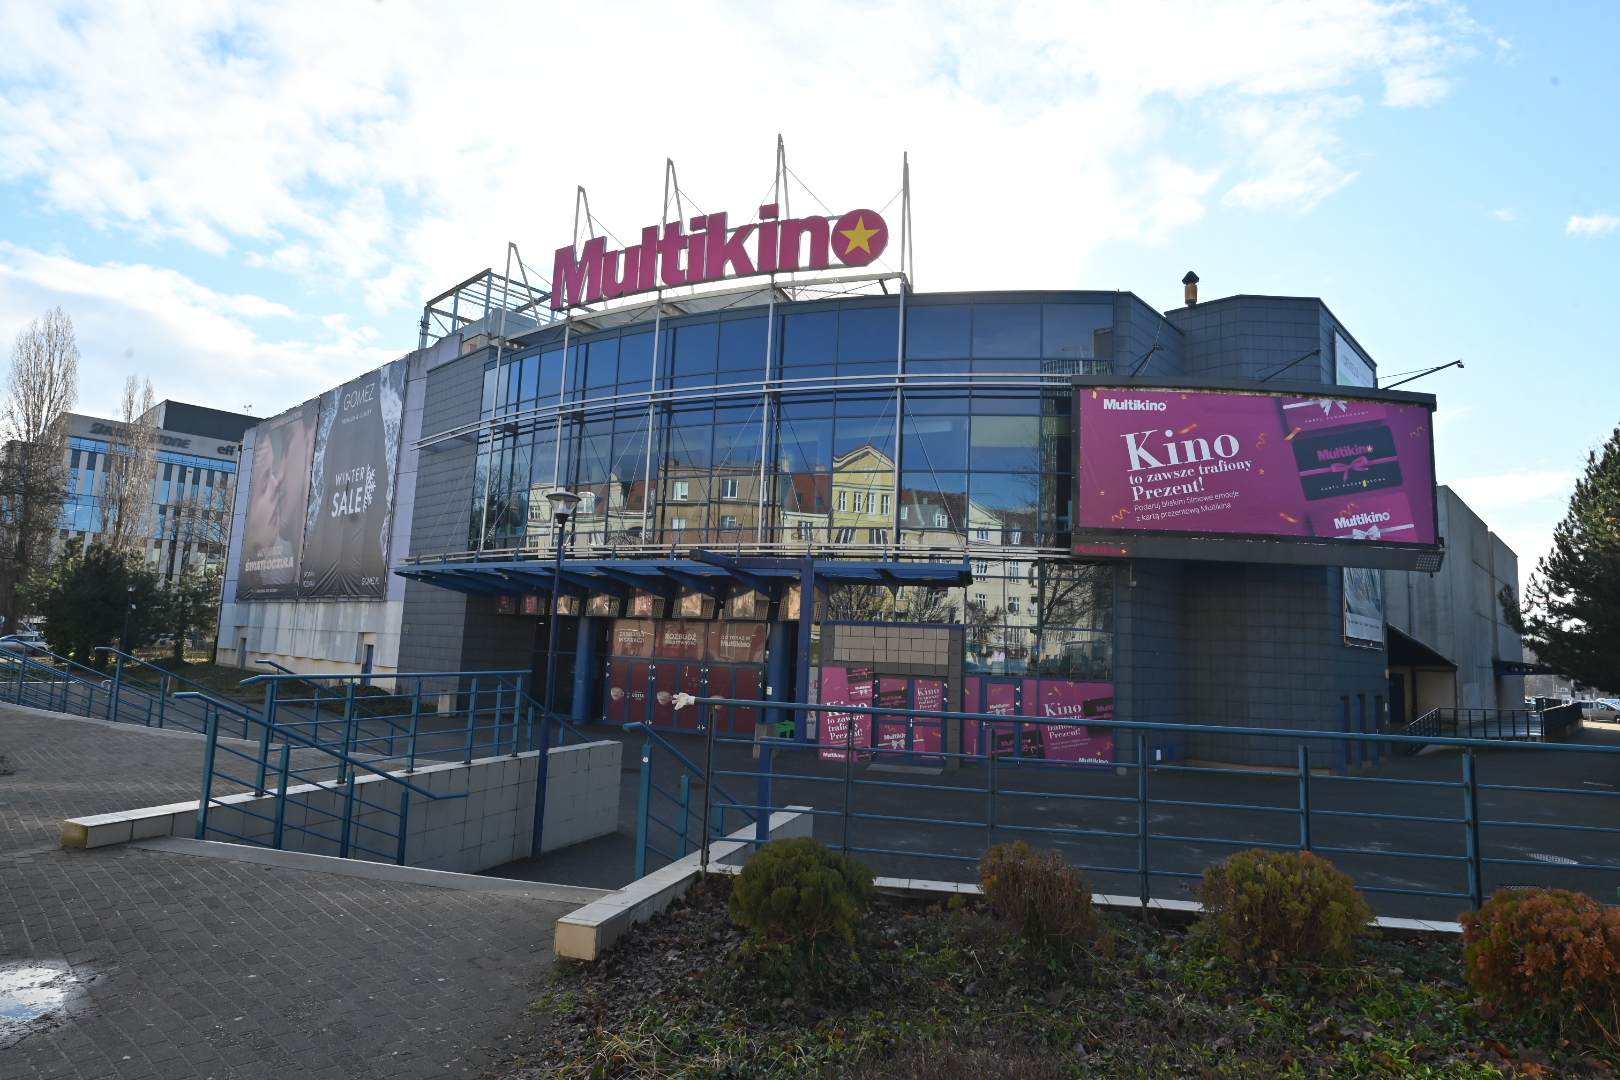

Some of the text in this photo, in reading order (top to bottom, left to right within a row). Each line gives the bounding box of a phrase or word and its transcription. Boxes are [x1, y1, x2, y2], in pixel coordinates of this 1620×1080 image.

[550, 203, 889, 311] Multikino
[343, 382, 375, 410] GOMEZ
[1103, 398, 1167, 412] Multikino
[1119, 429, 1240, 472] Kino
[1316, 444, 1374, 461] Multikino
[335, 466, 365, 487] WINTER
[1129, 459, 1252, 485] to zawsze trafiony
[1131, 476, 1205, 502] Prezent!
[331, 486, 363, 518] SALE
[1134, 490, 1240, 512] Podaruj bliskim filmowe emocje
[1141, 512, 1160, 521] kartą
[1160, 506, 1200, 519] prezentową
[1200, 502, 1232, 512] Multikina
[1333, 511, 1391, 529] Multikino
[1074, 544, 1129, 556] Multikino
[664, 632, 697, 641] ROZBUDŹ
[720, 640, 751, 648] Multikino
[917, 687, 940, 697] Kino
[1043, 702, 1082, 717] Kino
[1048, 727, 1081, 739] Prezent!
